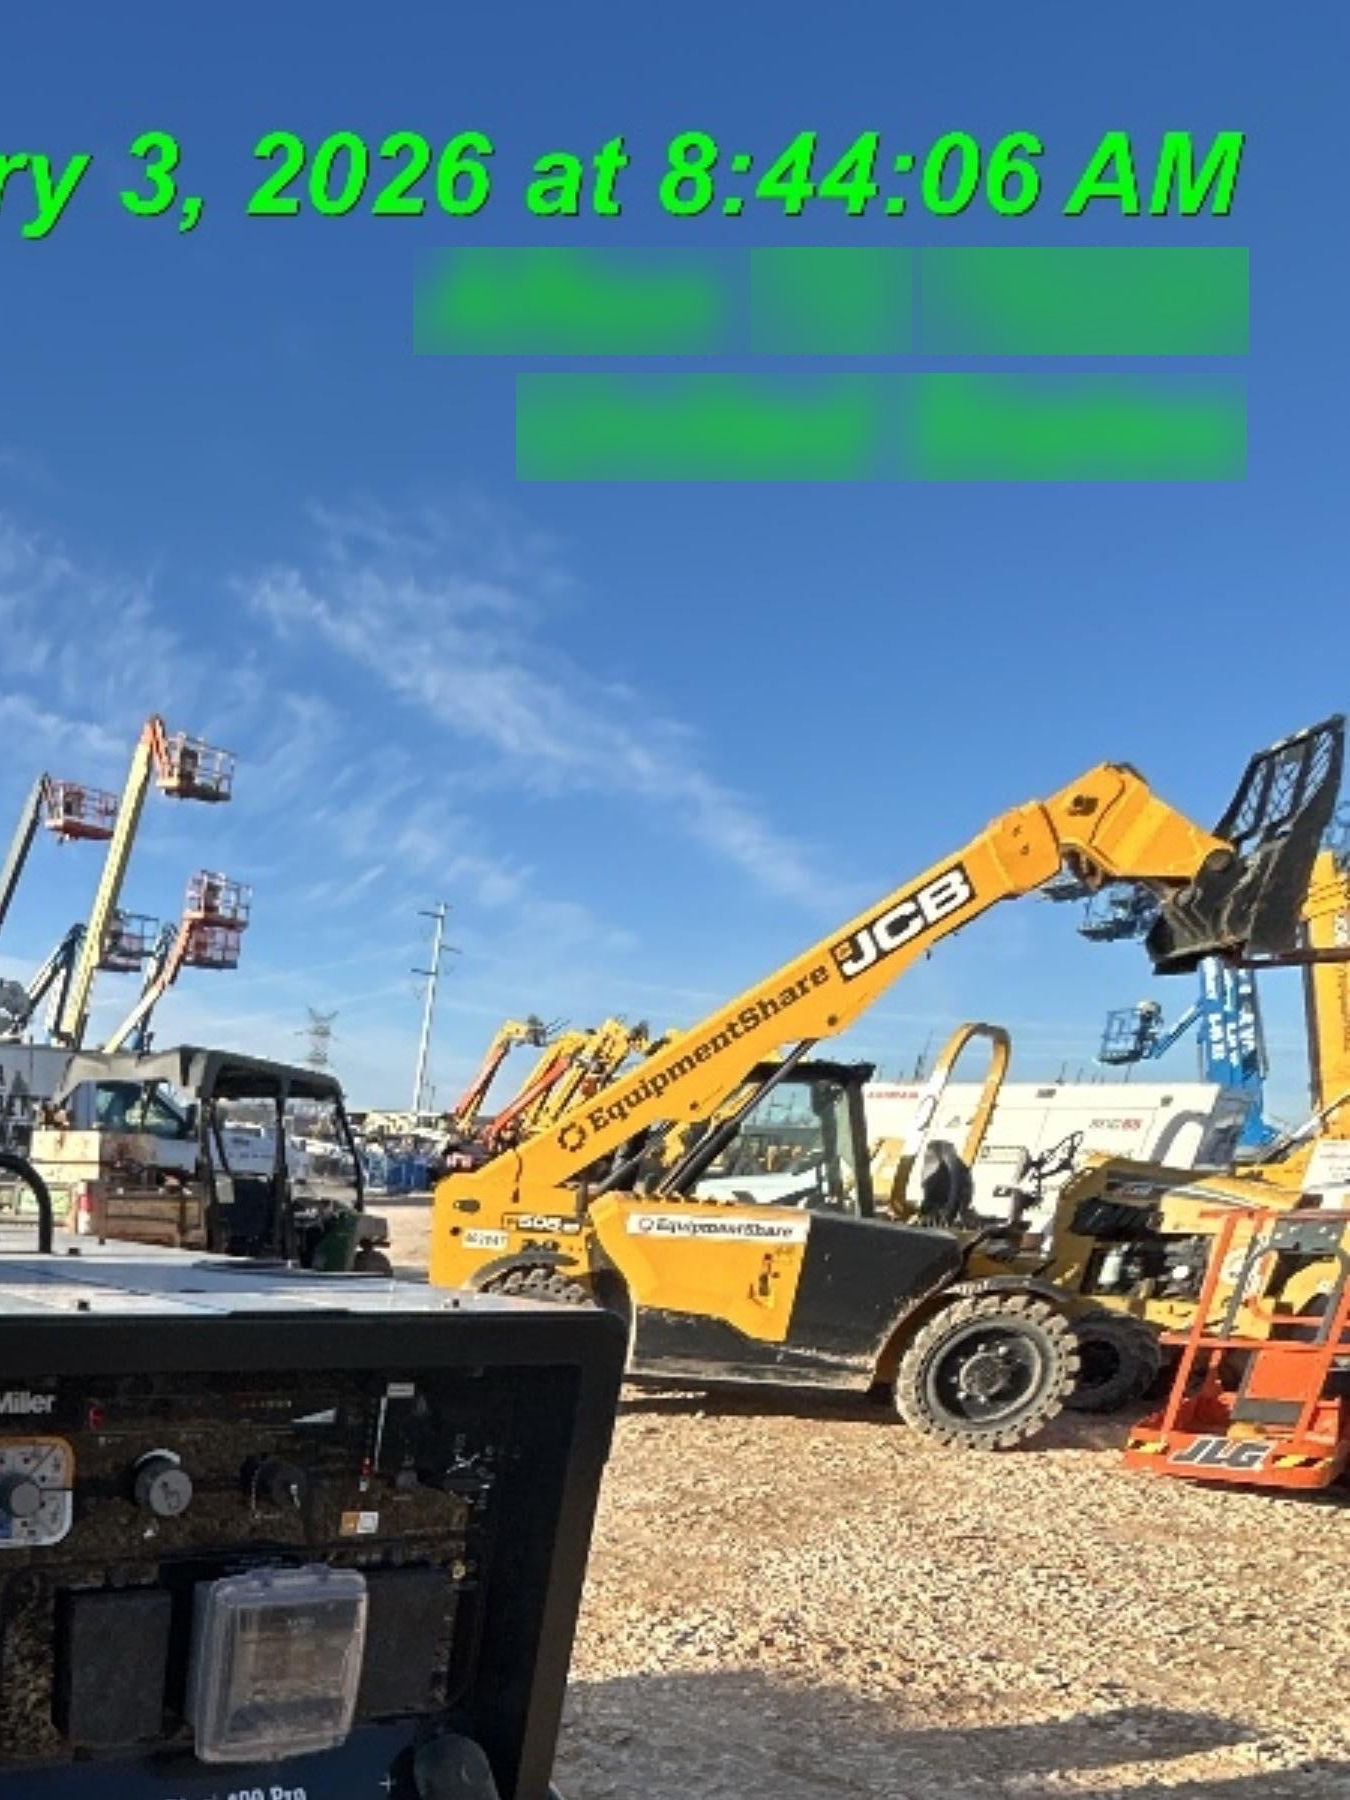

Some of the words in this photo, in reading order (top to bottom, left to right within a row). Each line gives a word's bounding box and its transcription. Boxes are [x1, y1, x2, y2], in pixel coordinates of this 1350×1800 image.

[840, 867, 973, 978] JCB
[586, 962, 831, 1134] EquipmentShare
[655, 1217, 794, 1237] EquipmentShare
[1168, 1436, 1276, 1471] JLG
